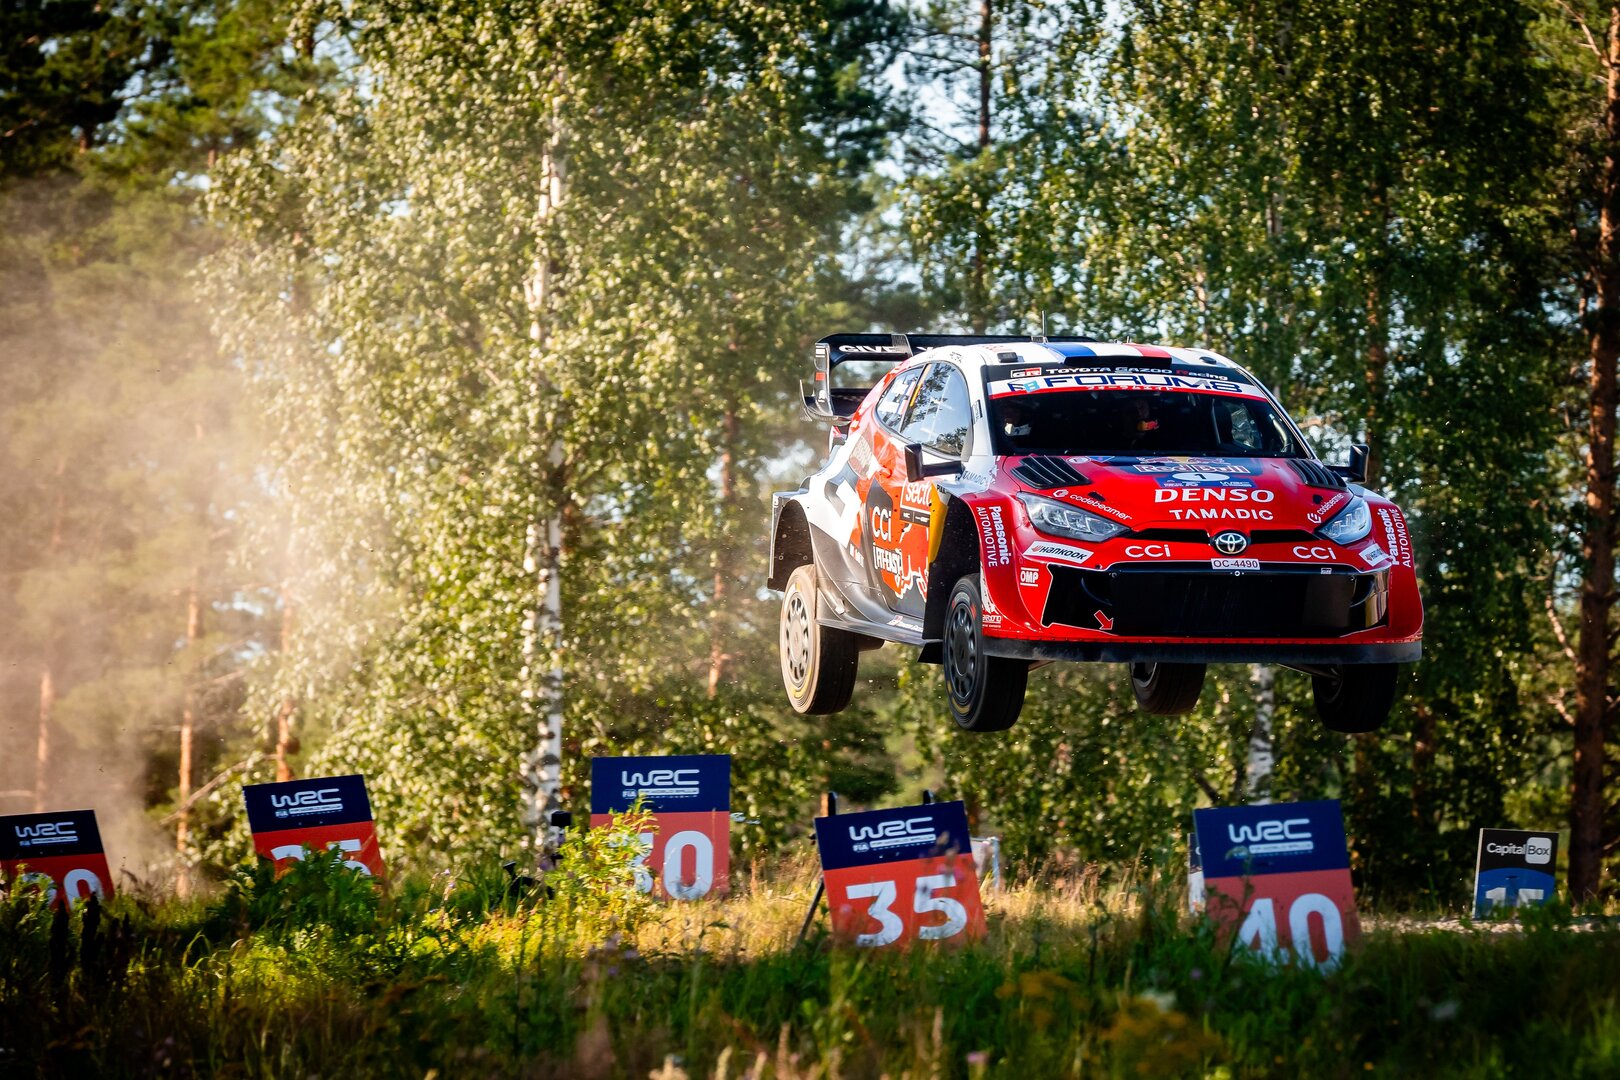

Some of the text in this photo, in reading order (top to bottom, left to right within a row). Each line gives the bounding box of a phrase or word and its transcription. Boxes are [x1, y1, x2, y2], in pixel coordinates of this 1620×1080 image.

[1114, 366, 1172, 374] GAZOO
[1043, 375, 1243, 393] FORUM8
[1133, 464, 1251, 473] Red Bull
[1154, 488, 1275, 503] DENSO
[1069, 494, 1132, 521] codebeamer
[1169, 508, 1274, 521] TAMADIC
[976, 506, 998, 568] AUTOMOTIVE
[988, 505, 1012, 565] Panasonic
[1377, 508, 1400, 566] Panasonic
[1388, 508, 1411, 568] AUTOMOTIVE
[1213, 559, 1259, 568] OC-4490
[1020, 570, 1039, 584] OMP
[621, 769, 700, 787] WRC
[270, 788, 342, 808] WRC
[15, 821, 77, 838] WRC
[848, 816, 936, 841] WRC
[1228, 818, 1313, 843] WRC
[845, 873, 968, 948] 35
[1231, 893, 1345, 974] 40
